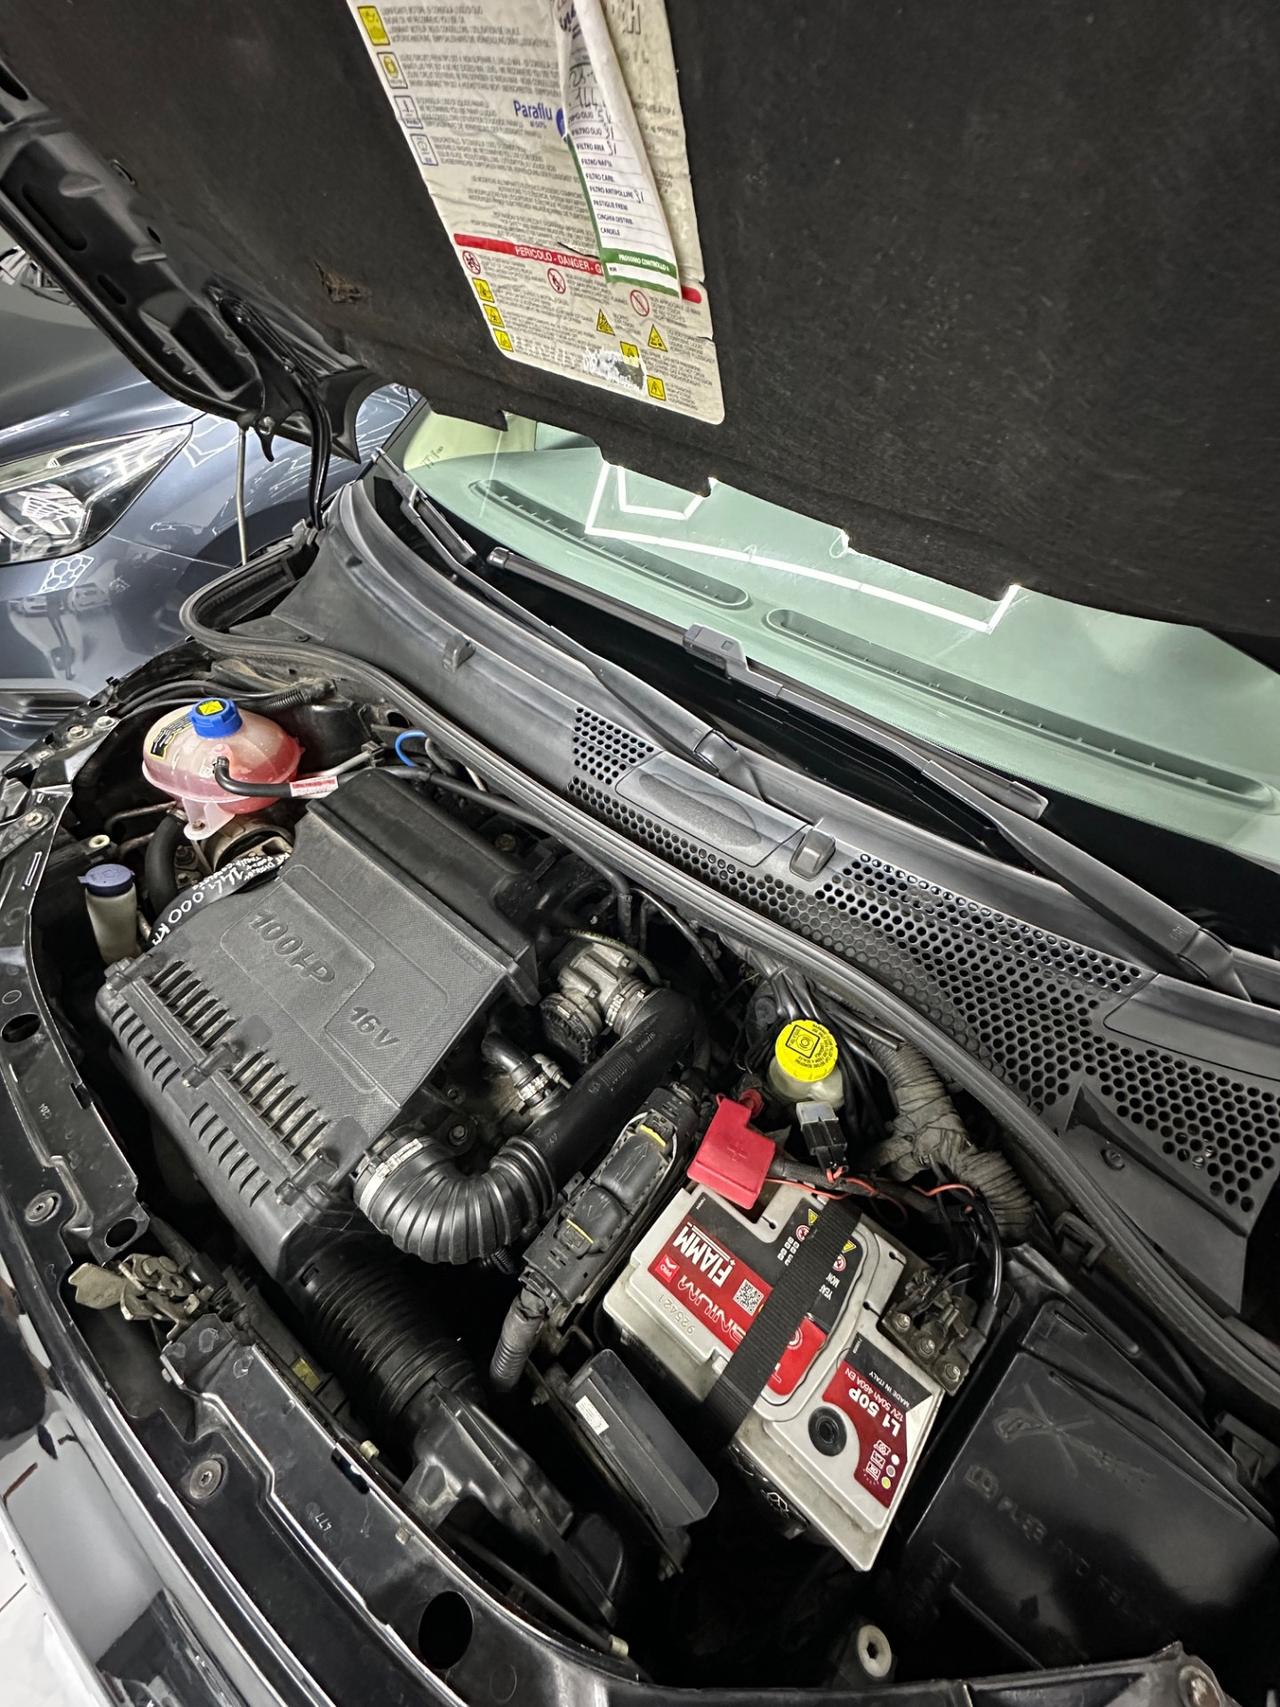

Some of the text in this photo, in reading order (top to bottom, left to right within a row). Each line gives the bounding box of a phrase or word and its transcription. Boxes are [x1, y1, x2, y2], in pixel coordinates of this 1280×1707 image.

[513, 99, 553, 120] Paraflu
[514, 245, 553, 262] PERICOLO
[557, 255, 590, 270] DANGER
[350, 1006, 400, 1050] 16V
[672, 1225, 734, 1288] FIAMM
[844, 1367, 904, 1422] 12V 50Ah 460A EN
[869, 1371, 911, 1408] MADE IN ITALY
[848, 1387, 901, 1438] L1 50P
